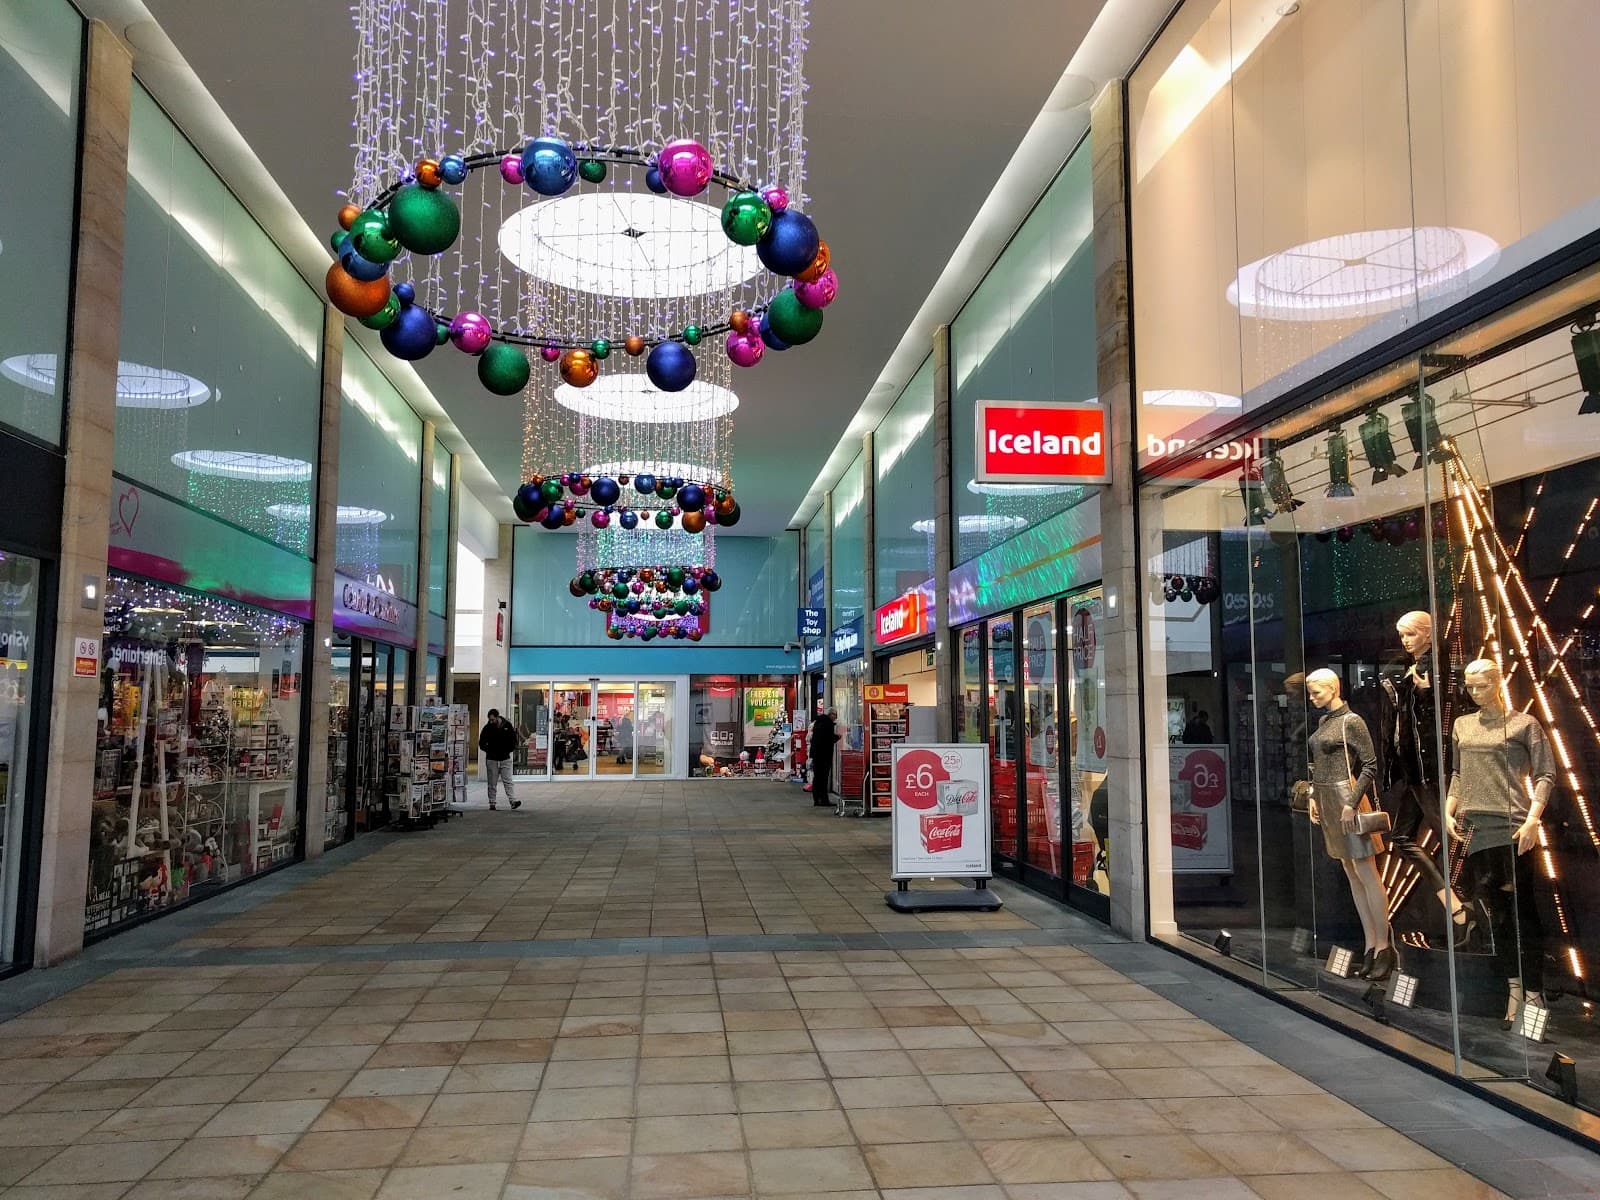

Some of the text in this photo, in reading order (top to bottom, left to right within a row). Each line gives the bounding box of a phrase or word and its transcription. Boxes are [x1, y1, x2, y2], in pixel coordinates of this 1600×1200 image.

[988, 430, 1101, 456] Iceland
[805, 618, 818, 627] Toy
[881, 605, 904, 636] Iceland
[802, 627, 822, 635] Shop
[1073, 624, 1094, 643] HALF
[750, 690, 765, 698] FREE
[905, 763, 934, 789] £6
[929, 824, 961, 840] Coca-Cola
